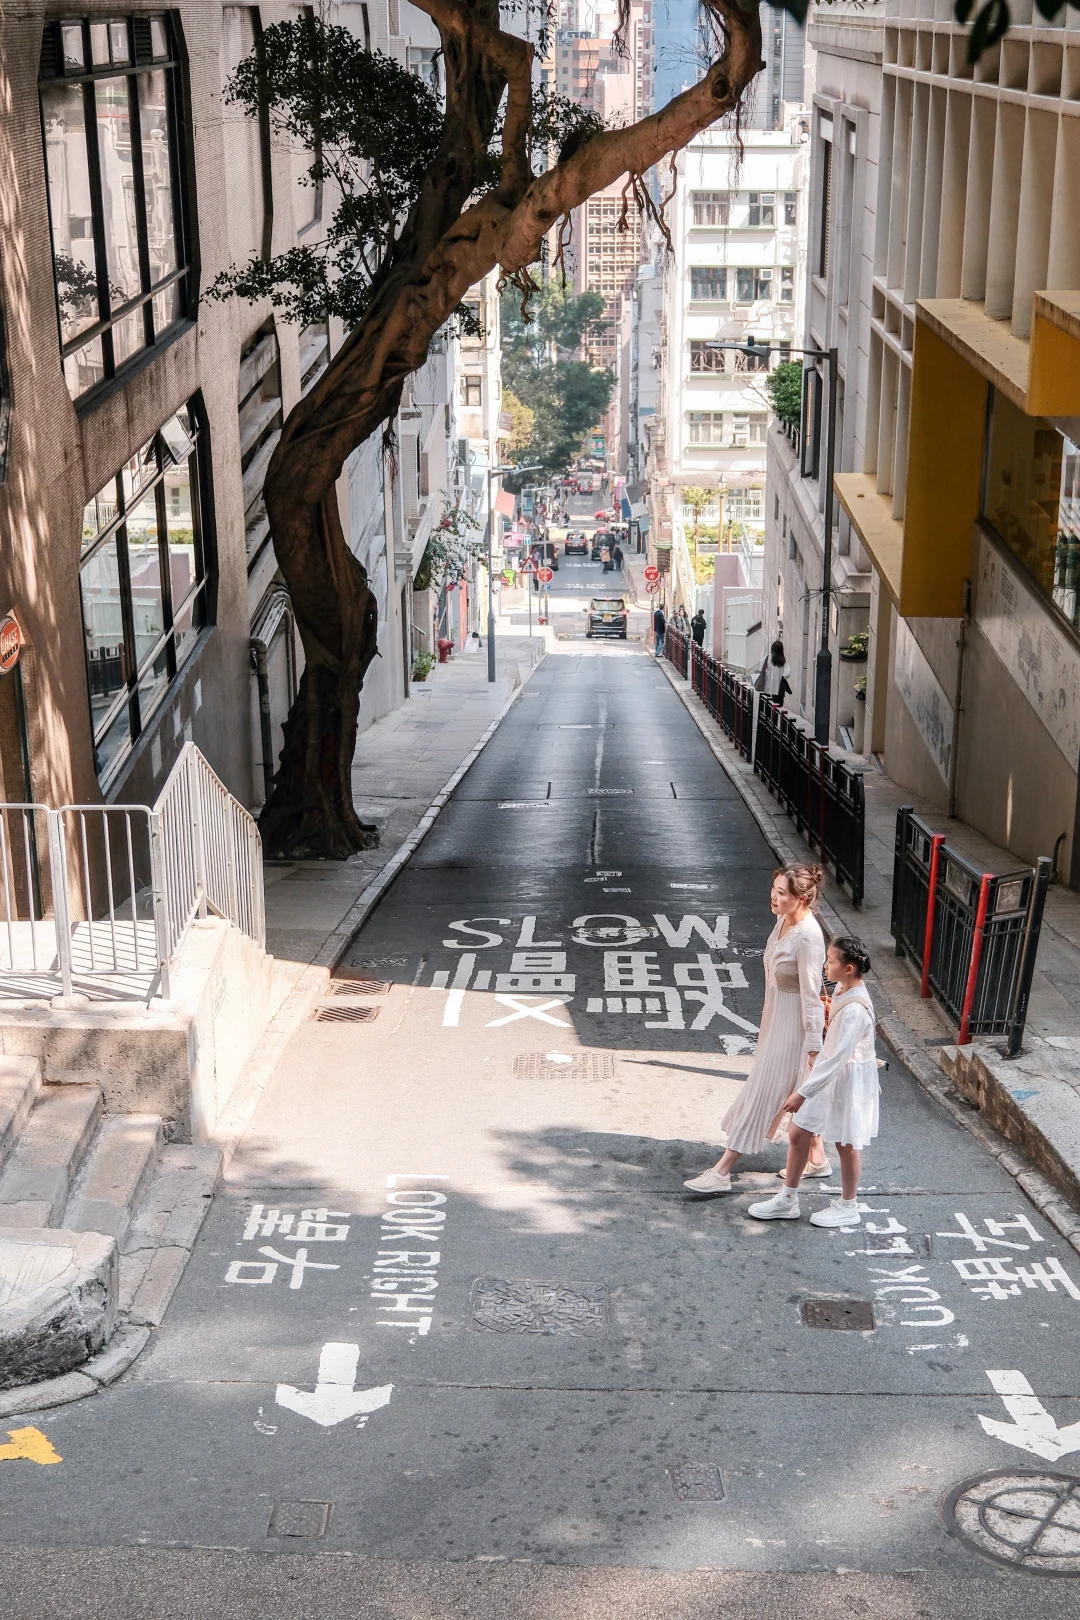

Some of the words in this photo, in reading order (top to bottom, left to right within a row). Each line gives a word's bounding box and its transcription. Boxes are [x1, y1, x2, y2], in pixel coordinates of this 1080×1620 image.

[441, 913, 731, 950] SLOW
[429, 951, 760, 1032] 慢駛
[224, 1204, 351, 1290] 望右
[379, 1173, 450, 1241] LOOK
[370, 1250, 441, 1338] RIGHT
[935, 1212, 1080, 1301] 望左
